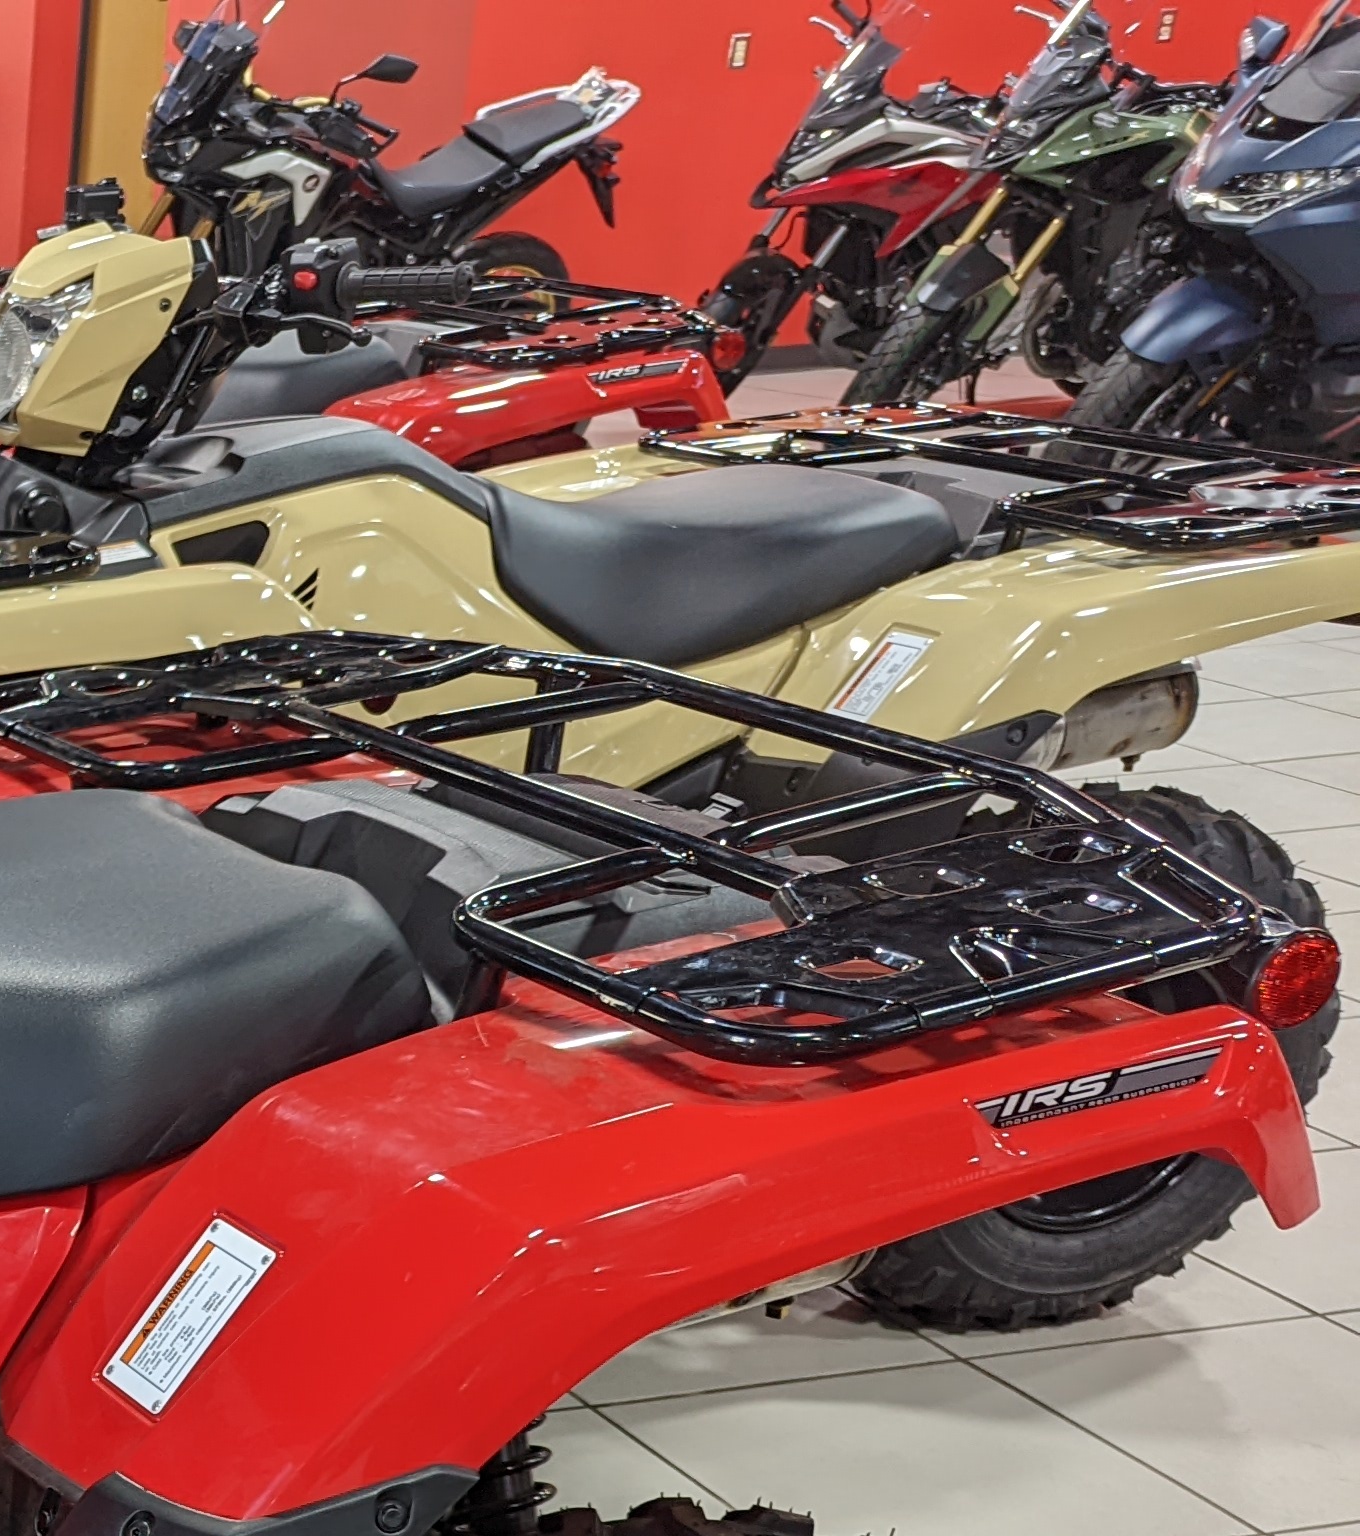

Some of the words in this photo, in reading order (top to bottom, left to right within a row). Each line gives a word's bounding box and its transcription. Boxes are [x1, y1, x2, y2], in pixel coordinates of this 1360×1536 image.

[598, 365, 641, 380] IRS
[1000, 1071, 1113, 1118] IRS
[1000, 1101, 1085, 1128] INDEPENDENT
[1122, 1077, 1197, 1100] SUSPENSION
[148, 1268, 195, 1326] WARNING
